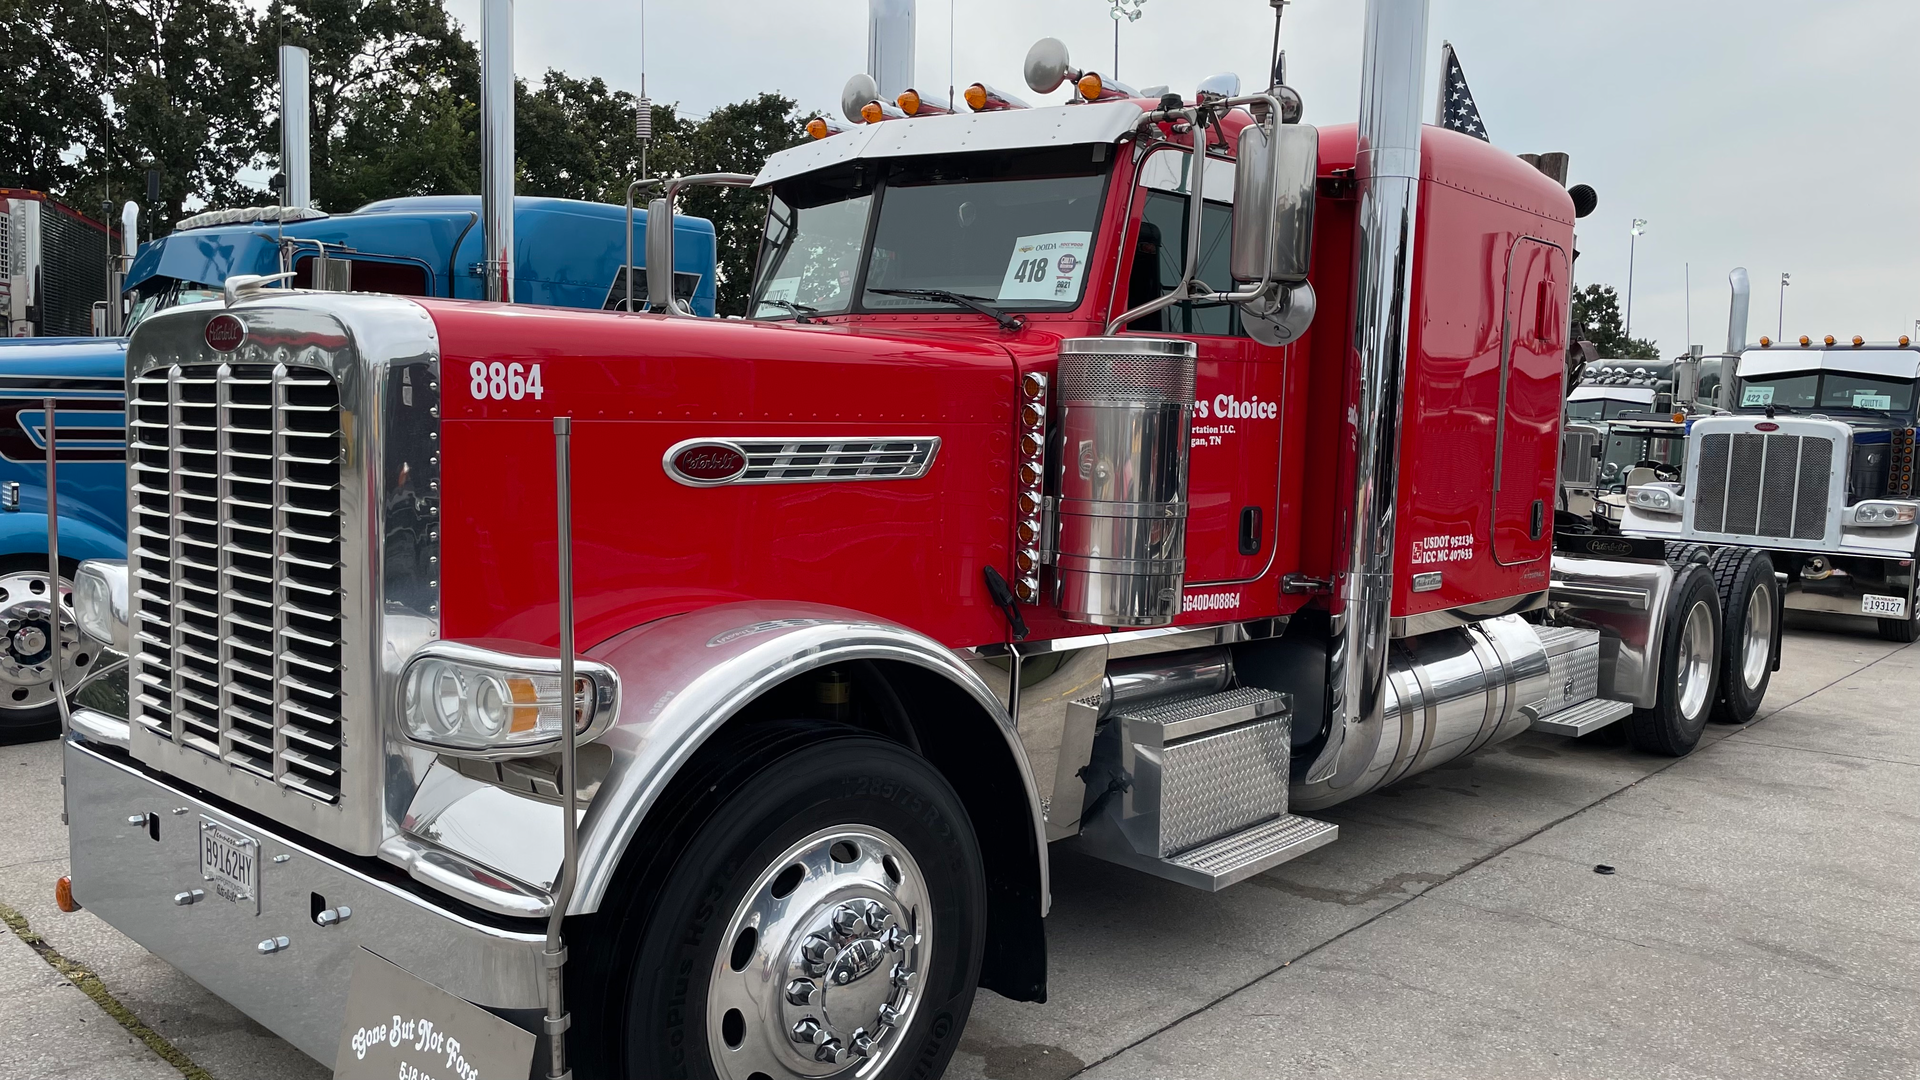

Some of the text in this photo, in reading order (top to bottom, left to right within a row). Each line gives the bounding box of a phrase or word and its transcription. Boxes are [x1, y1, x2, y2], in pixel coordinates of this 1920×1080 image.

[1014, 258, 1048, 283] 418
[1056, 280, 1071, 289] 2021
[470, 361, 544, 400] 8864
[1745, 394, 1761, 402] 422
[1214, 394, 1277, 419] Choice
[1191, 425, 1236, 434] rtation LLC.
[1190, 436, 1222, 448] gan, TN
[683, 450, 739, 471] Peterbilt
[1423, 535, 1450, 550] USDOT
[1422, 551, 1437, 564] ICC
[1437, 549, 1449, 562] MC
[1449, 548, 1473, 562] 407633
[1869, 600, 1902, 613] 193127
[206, 837, 252, 886] B9162HY
[352, 1026, 387, 1060] Gone
[389, 1015, 415, 1048] But
[415, 1018, 444, 1054] Not
